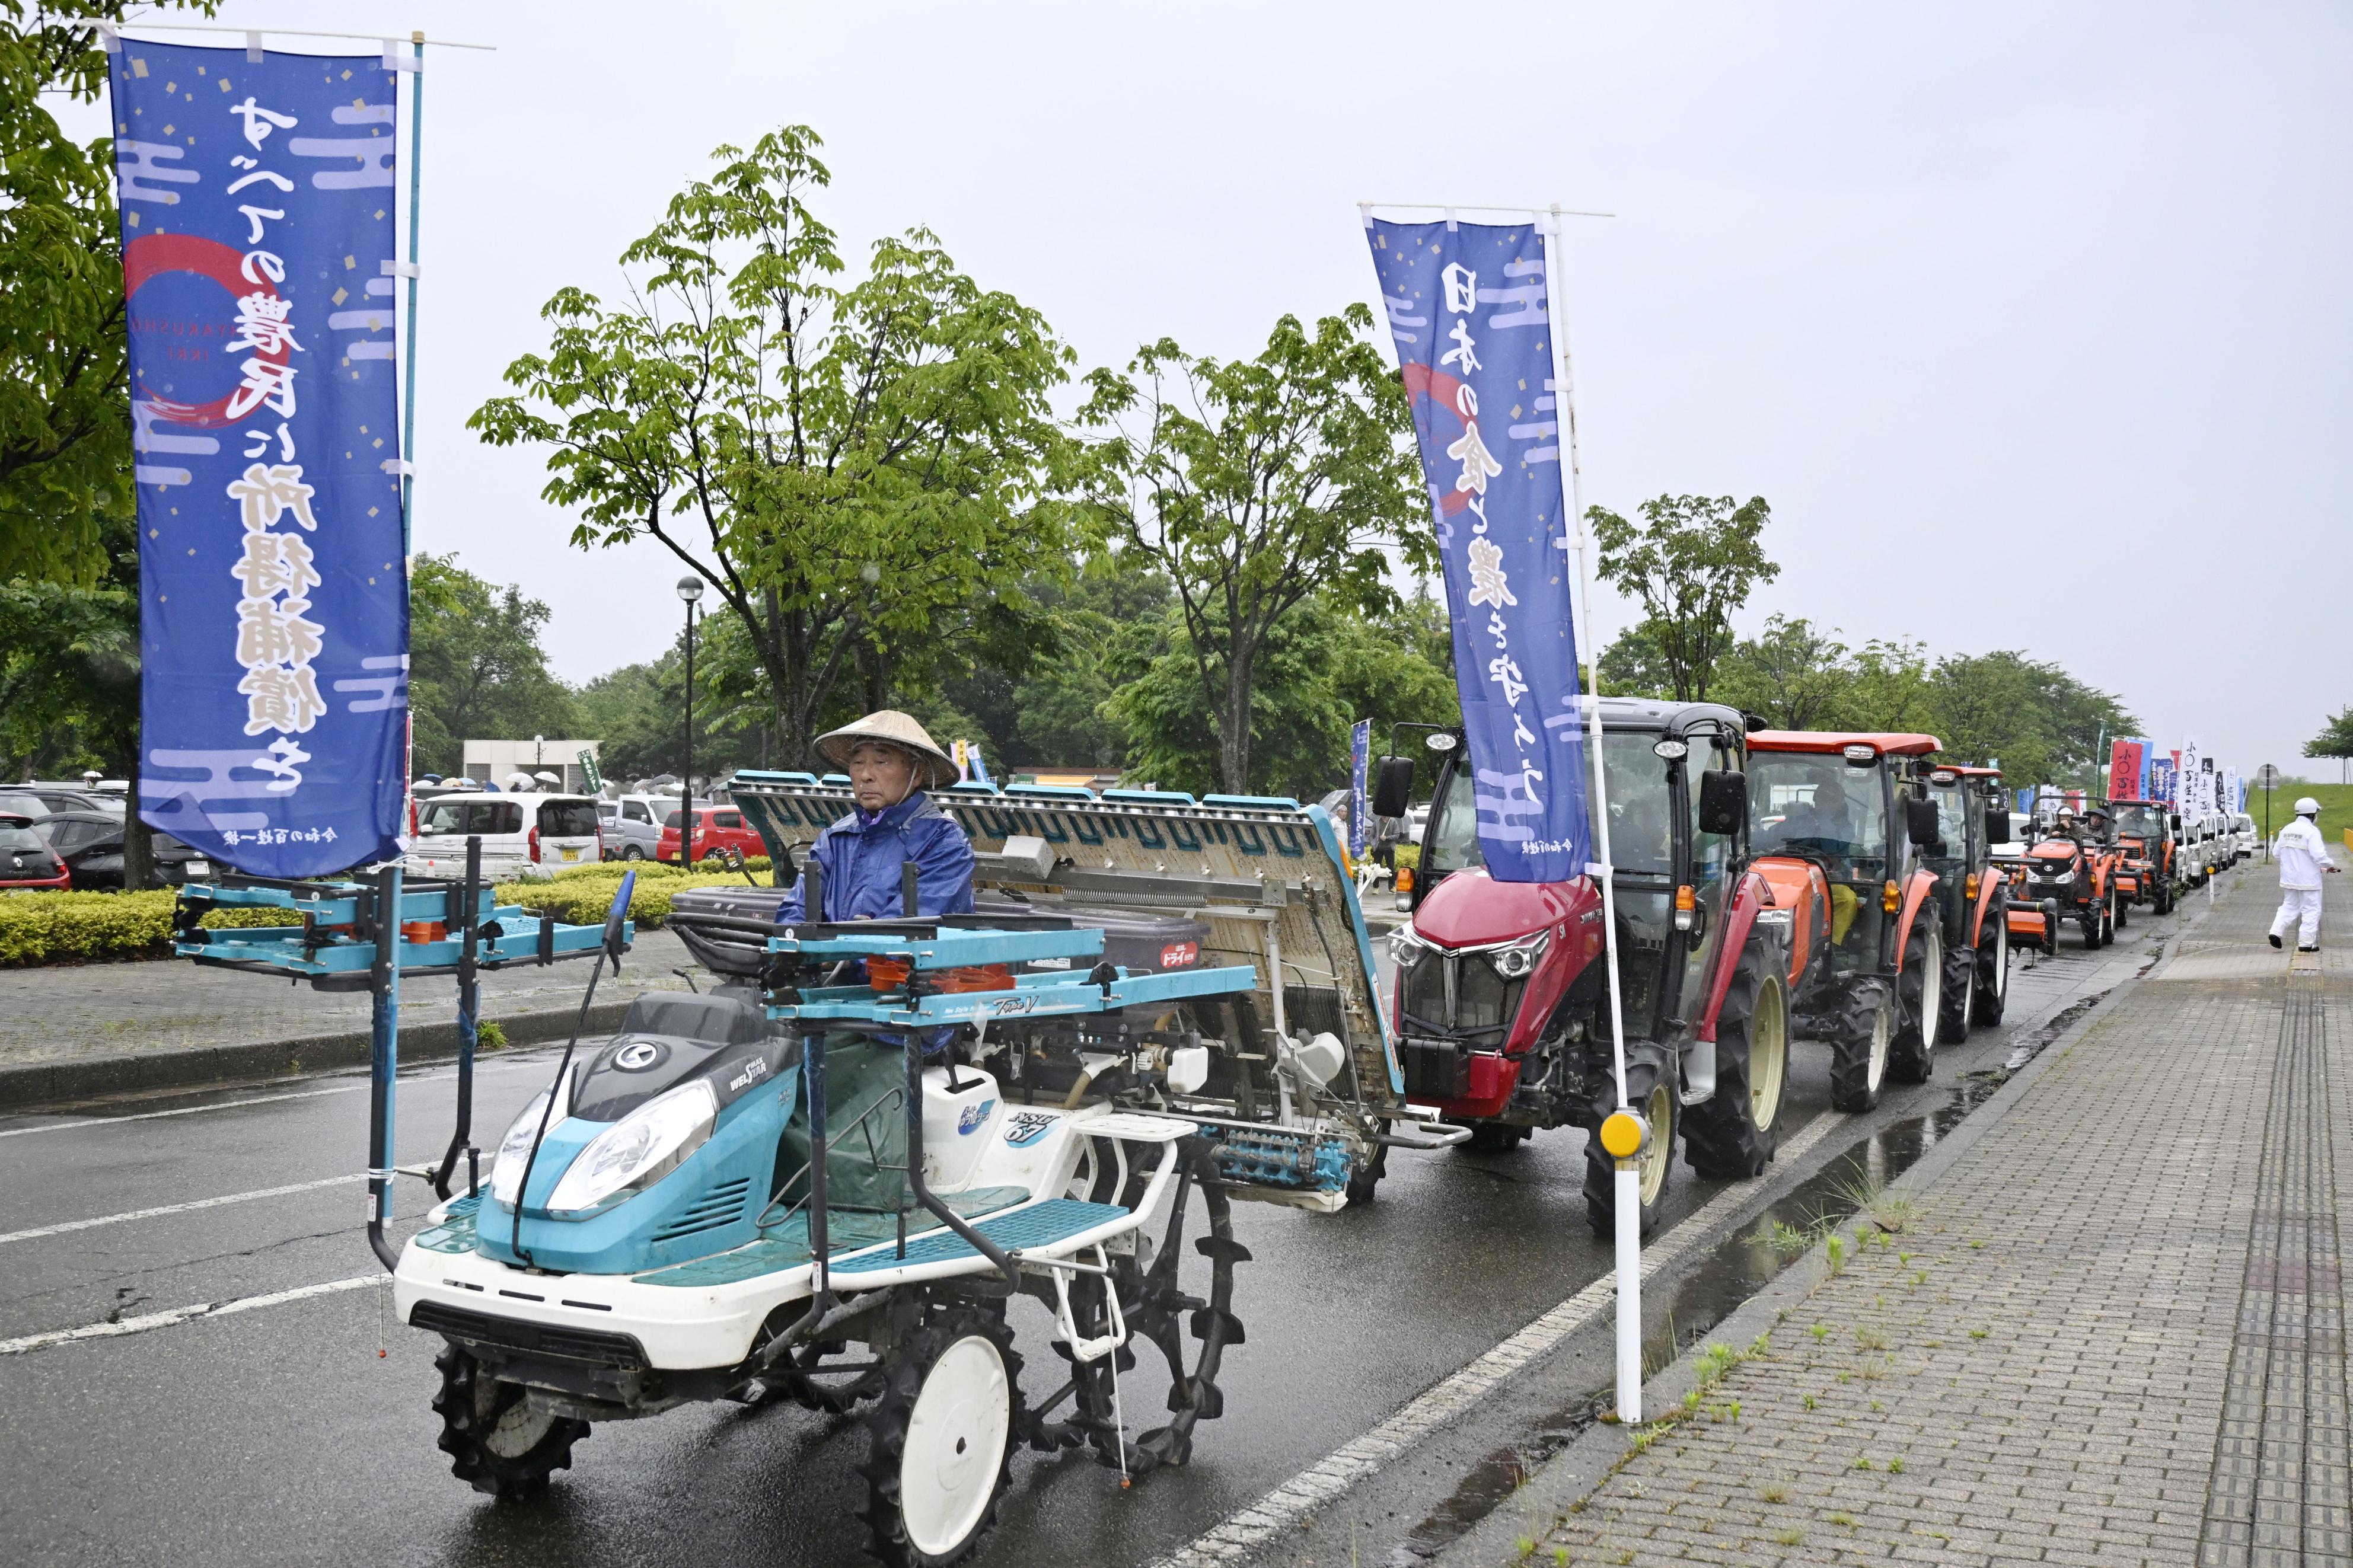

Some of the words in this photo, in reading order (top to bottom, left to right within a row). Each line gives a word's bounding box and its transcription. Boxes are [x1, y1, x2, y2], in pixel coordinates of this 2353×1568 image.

[1163, 951, 1185, 966] ドライ
[993, 997, 1025, 1015] Type
[1025, 995, 1040, 1013] V
[750, 1056, 763, 1068] MAX
[1008, 1112, 1061, 1125] NSU
[1004, 1123, 1047, 1144] 67
